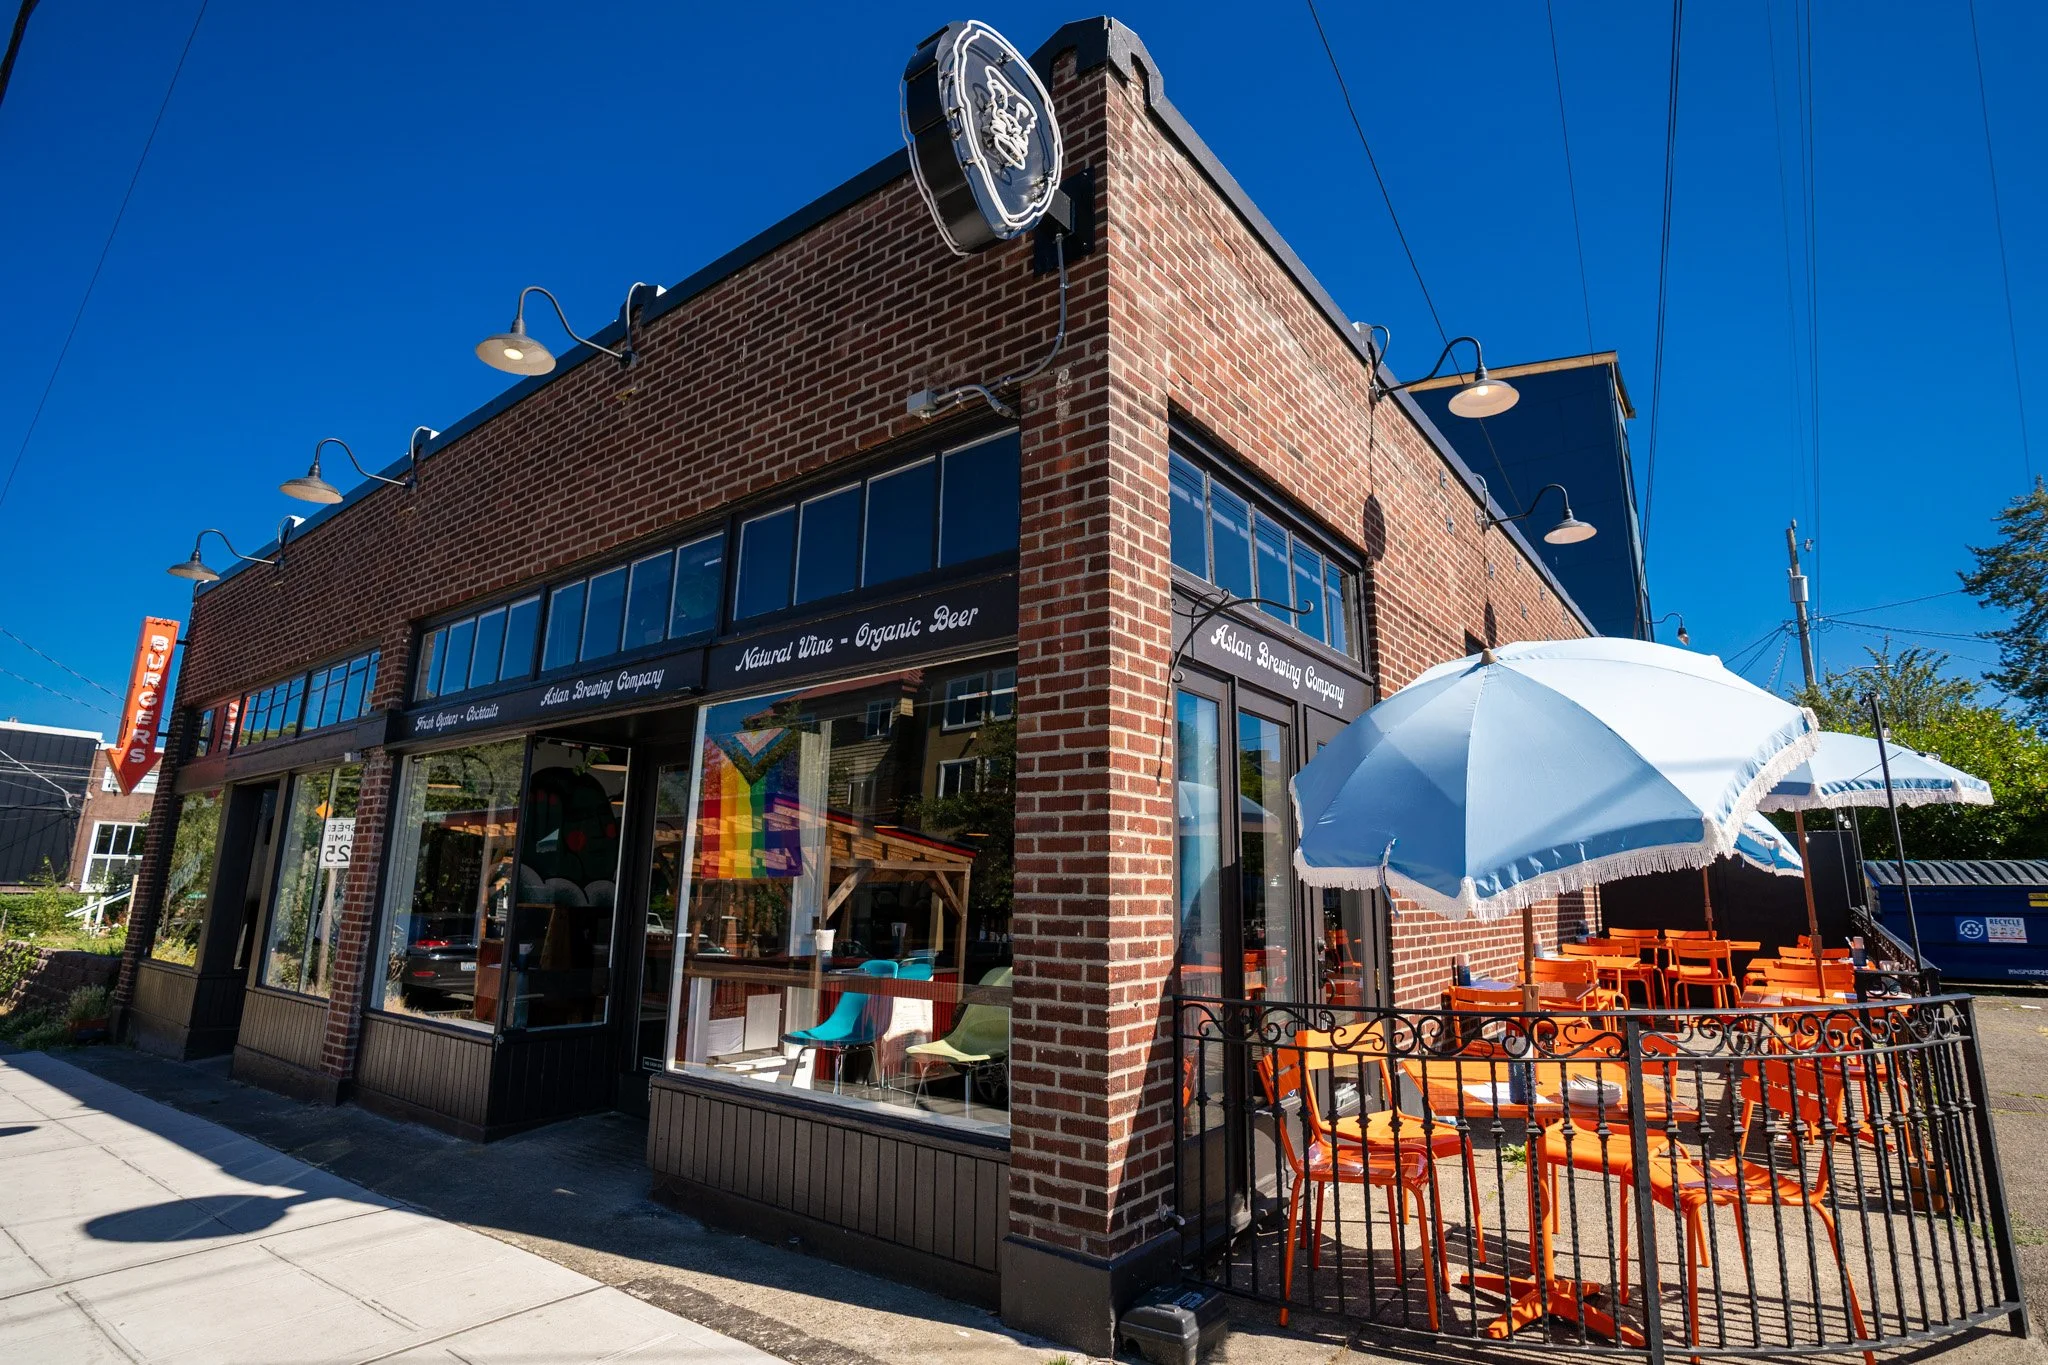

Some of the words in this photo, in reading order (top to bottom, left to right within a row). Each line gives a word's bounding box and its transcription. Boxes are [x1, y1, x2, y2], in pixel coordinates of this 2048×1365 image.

[735, 642, 793, 672] Natural
[798, 635, 834, 660] Wine
[855, 617, 922, 651] Organic
[929, 605, 978, 633] Beer
[540, 686, 569, 706] Aslan
[572, 680, 613, 699] Brewing
[617, 669, 664, 693] Company
[1210, 624, 1252, 661] Aslan
[1256, 641, 1302, 690] Brewing
[1305, 665, 1345, 710] Company
[129, 634, 169, 763] BURGERS
[466, 703, 499, 722] Cocktails
[1989, 918, 2022, 926] RECYCLE
